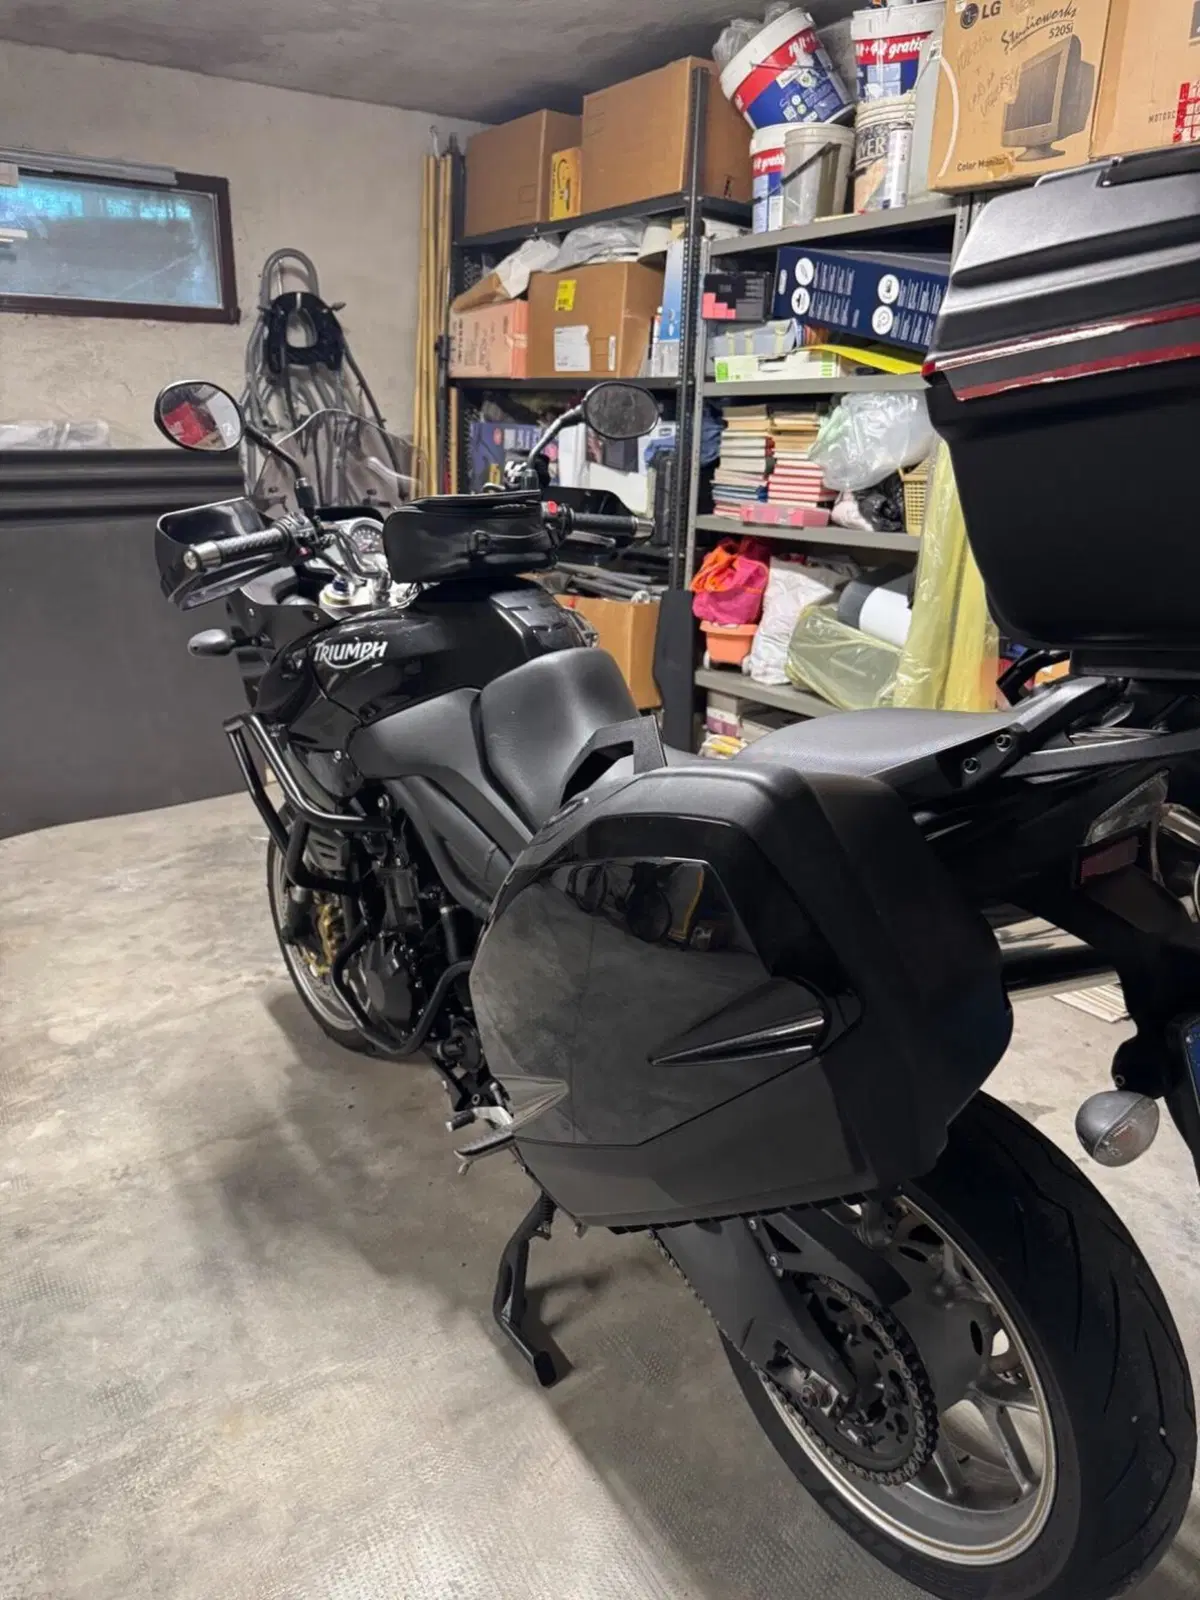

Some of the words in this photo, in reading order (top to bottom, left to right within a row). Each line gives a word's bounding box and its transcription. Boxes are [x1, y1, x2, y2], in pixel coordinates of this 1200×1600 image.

[980, 1, 1001, 19] LG
[957, 160, 977, 172] Color
[313, 640, 388, 669] TRIUMPH
